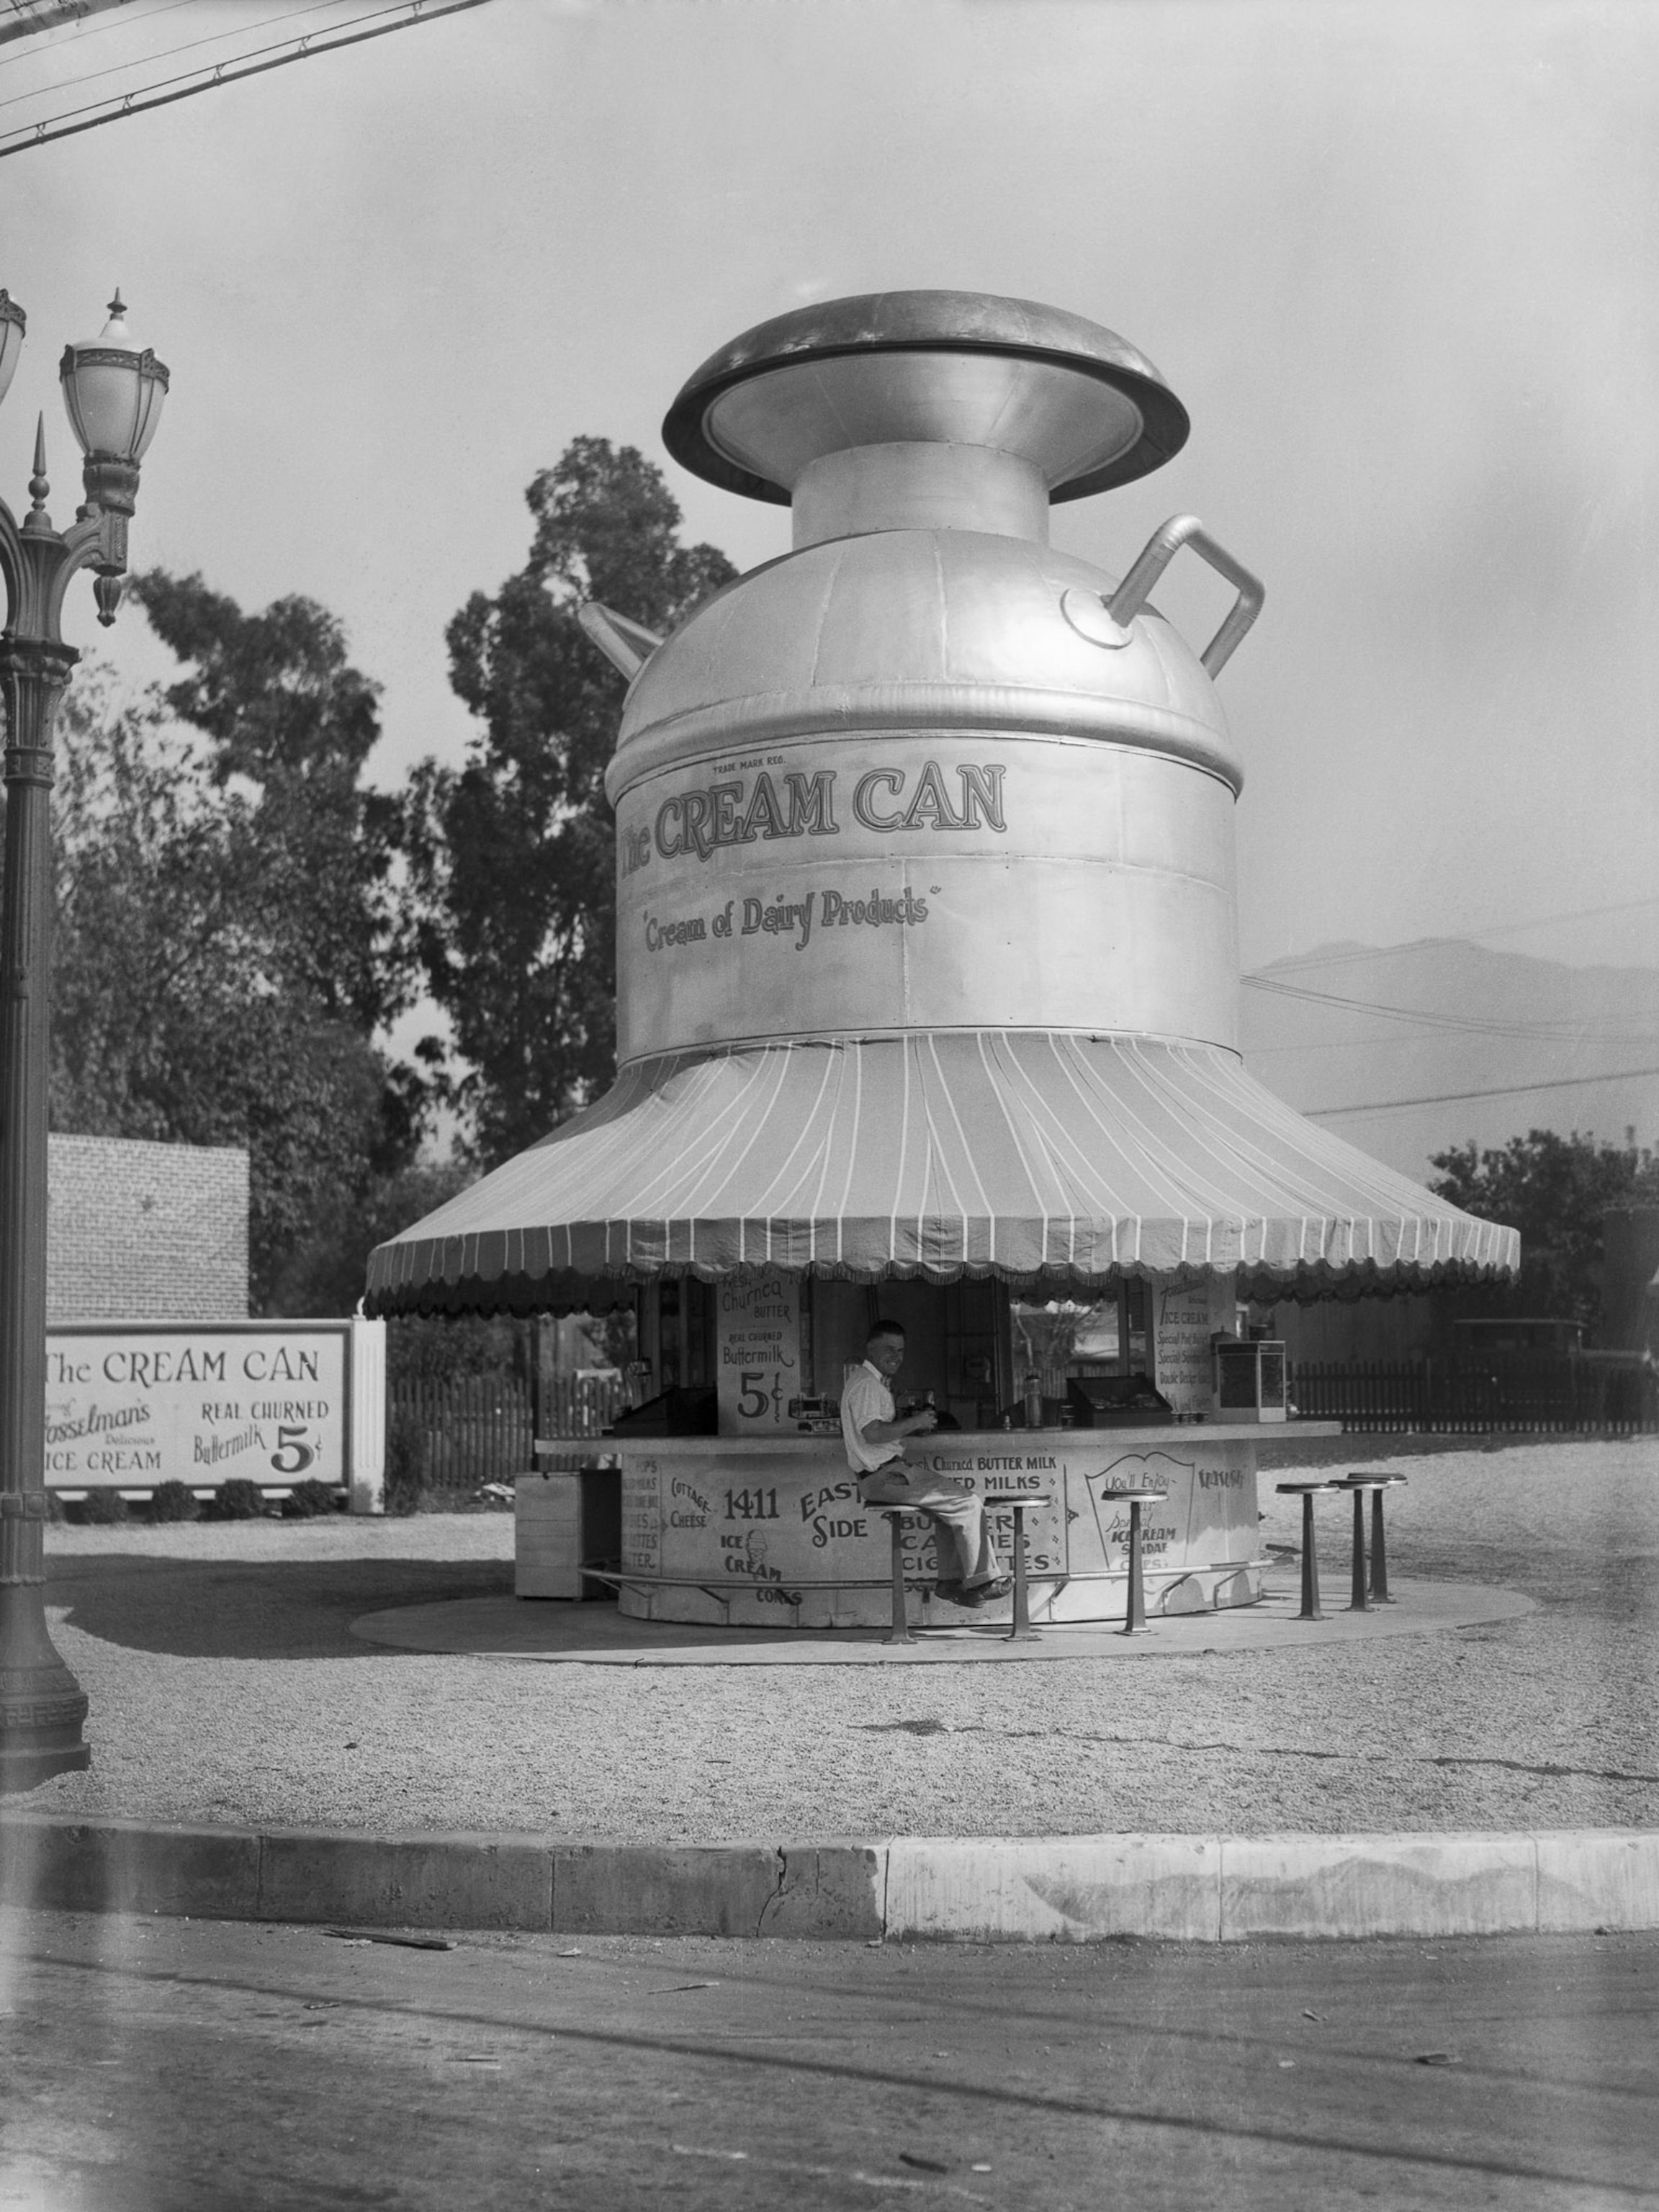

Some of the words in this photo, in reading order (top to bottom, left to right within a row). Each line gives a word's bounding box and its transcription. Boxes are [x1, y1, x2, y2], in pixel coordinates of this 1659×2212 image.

[713, 763, 736, 775] TRADE
[739, 758, 763, 770] MARK
[767, 755, 786, 765] REG.
[621, 824, 652, 878] The
[655, 770, 840, 862] CREAM
[853, 760, 1008, 832] CAN
[712, 899, 735, 938] of
[741, 891, 815, 951] Dairy
[754, 1305, 792, 1323] BUTTER
[1164, 1311, 1179, 1325] ICE
[1181, 1311, 1209, 1326] CREAM
[729, 1333, 746, 1345] REAL
[748, 1331, 783, 1344] CHURNED
[723, 1344, 795, 1368] Buttermilk
[103, 1348, 226, 1388] CREAM
[243, 1346, 320, 1382] CAN
[202, 1402, 240, 1424] REAL
[251, 1401, 329, 1422] CHURNED
[104, 1433, 156, 1446] Delicious
[194, 1424, 267, 1465] Buttermilk
[45, 1450, 78, 1471] ICE
[87, 1450, 162, 1475] CREAM
[932, 1455, 974, 1471] Churned
[977, 1457, 1022, 1471] BUTTER
[1026, 1455, 1057, 1470] MILK
[985, 1475, 1041, 1490] MILKS
[671, 1477, 712, 1514] COTTAGE
[724, 1488, 780, 1520] 1411
[801, 1482, 862, 1522] EAST
[670, 1510, 708, 1529] CHEESE
[901, 1514, 1015, 1534] BUER
[1106, 1510, 1154, 1532] Spal
[812, 1515, 868, 1547] SIDE
[1111, 1530, 1131, 1543] ICE
[1141, 1527, 1177, 1541] REAM
[721, 1534, 744, 1550] ICE
[902, 1534, 1030, 1550] CAIES
[1120, 1542, 1169, 1555] SDAE
[725, 1555, 782, 1583] CREAM
